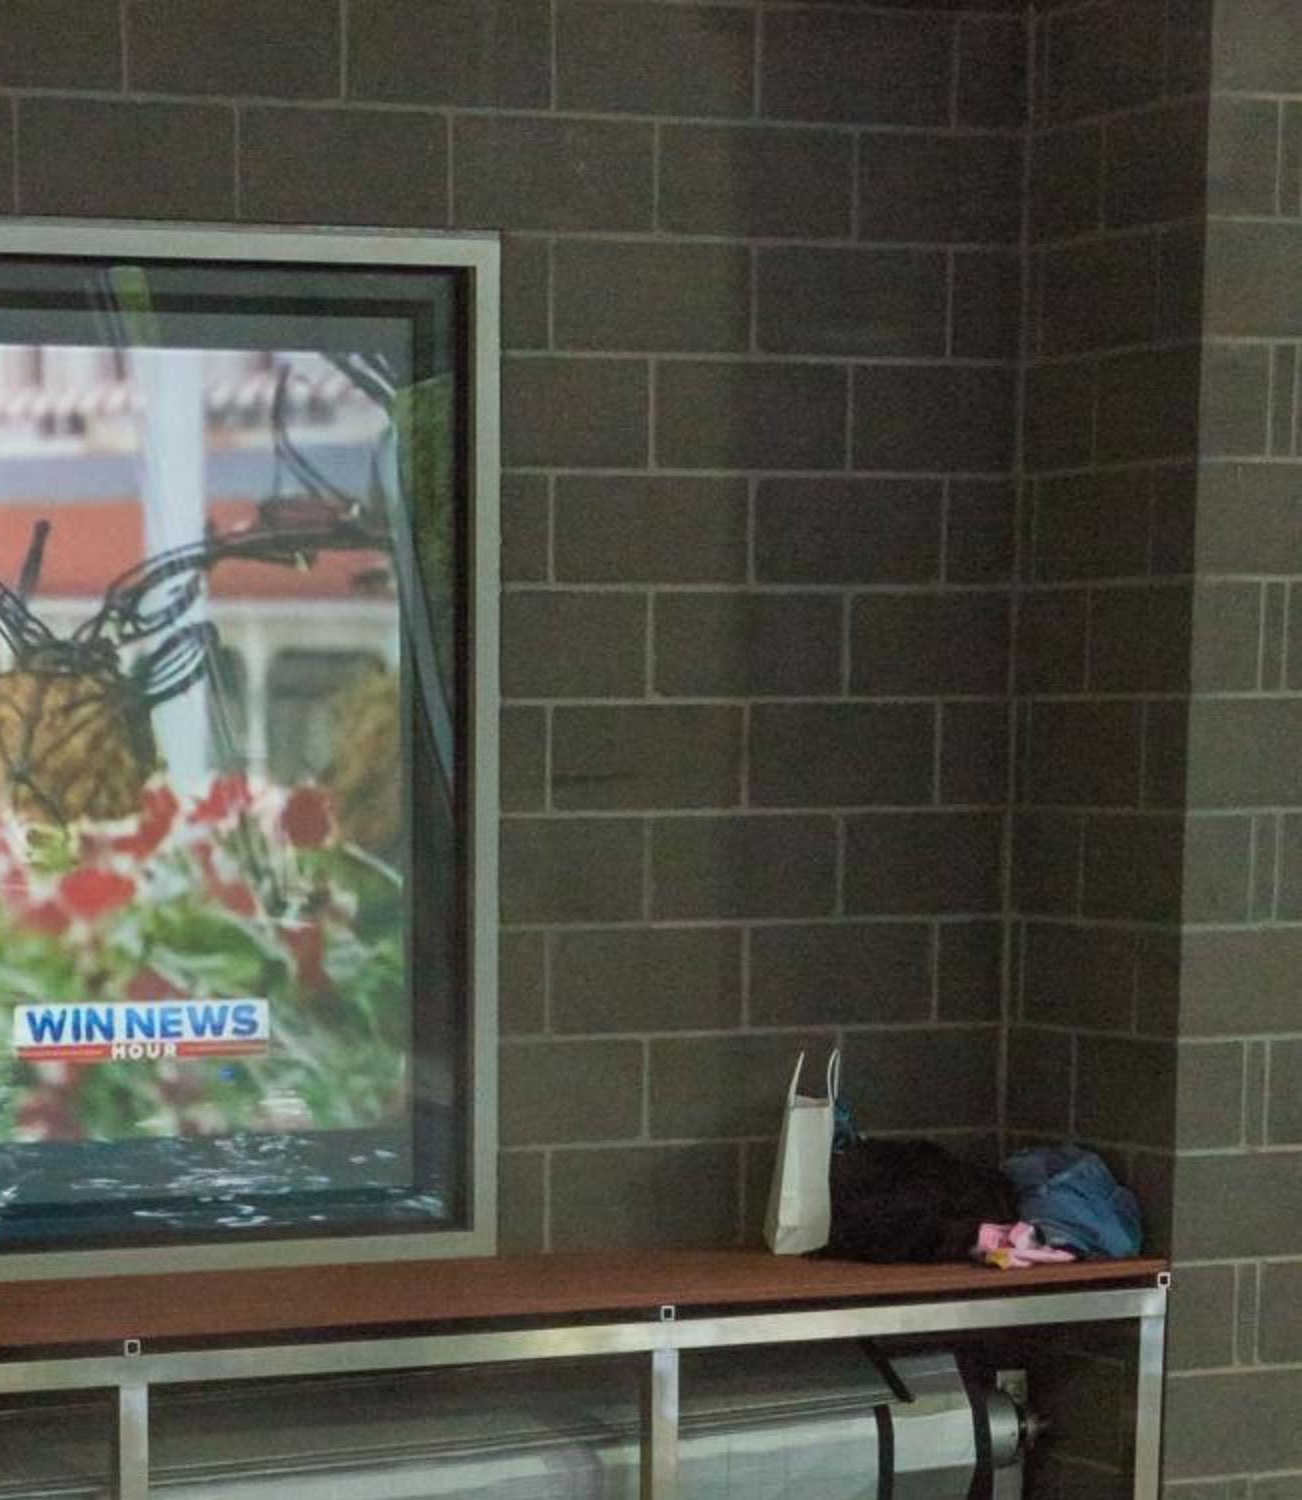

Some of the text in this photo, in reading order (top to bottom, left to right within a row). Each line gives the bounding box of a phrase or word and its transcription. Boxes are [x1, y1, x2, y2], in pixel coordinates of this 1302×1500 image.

[26, 1004, 258, 1043] WIN NEWS
[111, 1043, 177, 1059] HOUR
